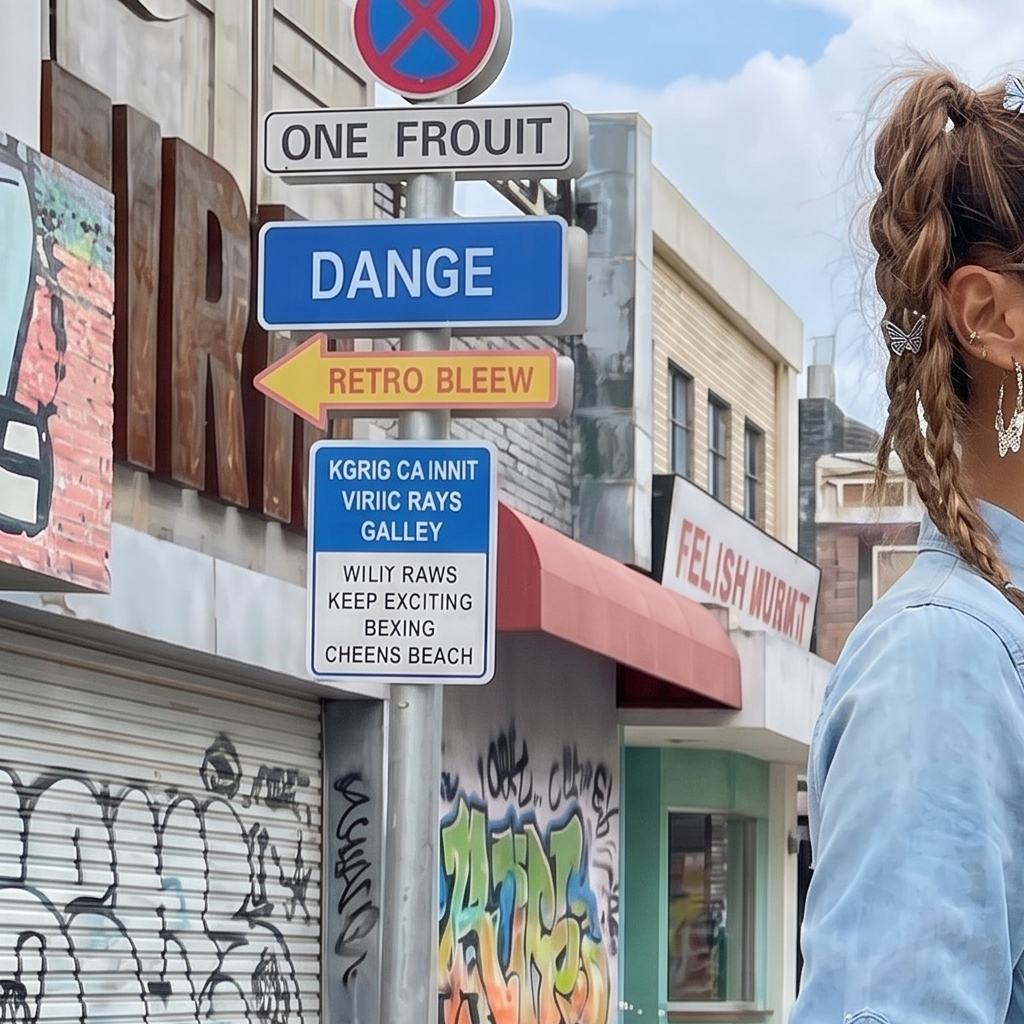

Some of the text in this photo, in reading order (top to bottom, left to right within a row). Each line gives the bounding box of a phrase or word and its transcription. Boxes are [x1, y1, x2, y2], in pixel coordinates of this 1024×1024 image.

[281, 117, 553, 161] ONE FROUIT
[311, 247, 494, 300] DANGE
[329, 366, 534, 395] RETRO BLEEW
[329, 459, 391, 481] KGRIG
[342, 490, 463, 512] VIRIIC RAYS
[361, 521, 443, 542] GALLEY
[402, 566, 458, 584] RAWS
[675, 518, 749, 611] FELISH
[328, 592, 473, 611] KEEP EXCITING
[364, 619, 435, 638] BEXING
[325, 646, 473, 665] CHEENS BEACH
